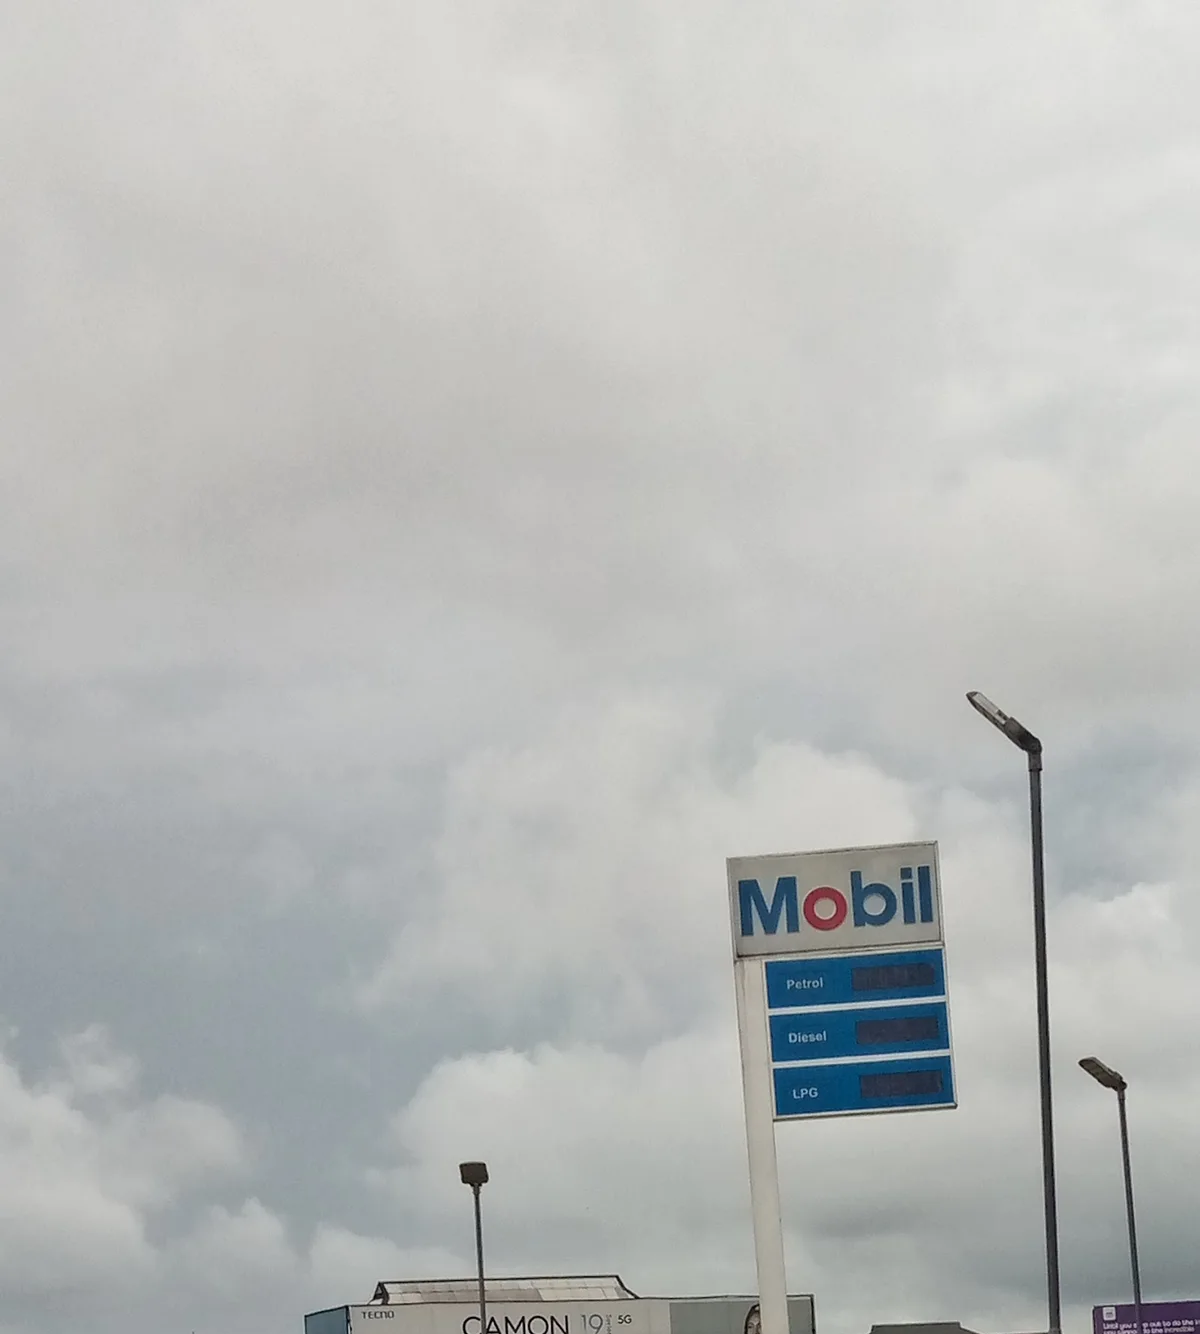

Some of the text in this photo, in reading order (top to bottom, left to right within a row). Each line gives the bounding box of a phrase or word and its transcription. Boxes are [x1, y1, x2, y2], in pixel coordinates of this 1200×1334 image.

[738, 865, 933, 937] Mobil
[786, 977, 824, 990] Petrol
[788, 1030, 827, 1043] Diesel
[793, 1087, 819, 1099] LPG
[361, 1310, 395, 1319] TECNO
[617, 1314, 633, 1324] 5G
